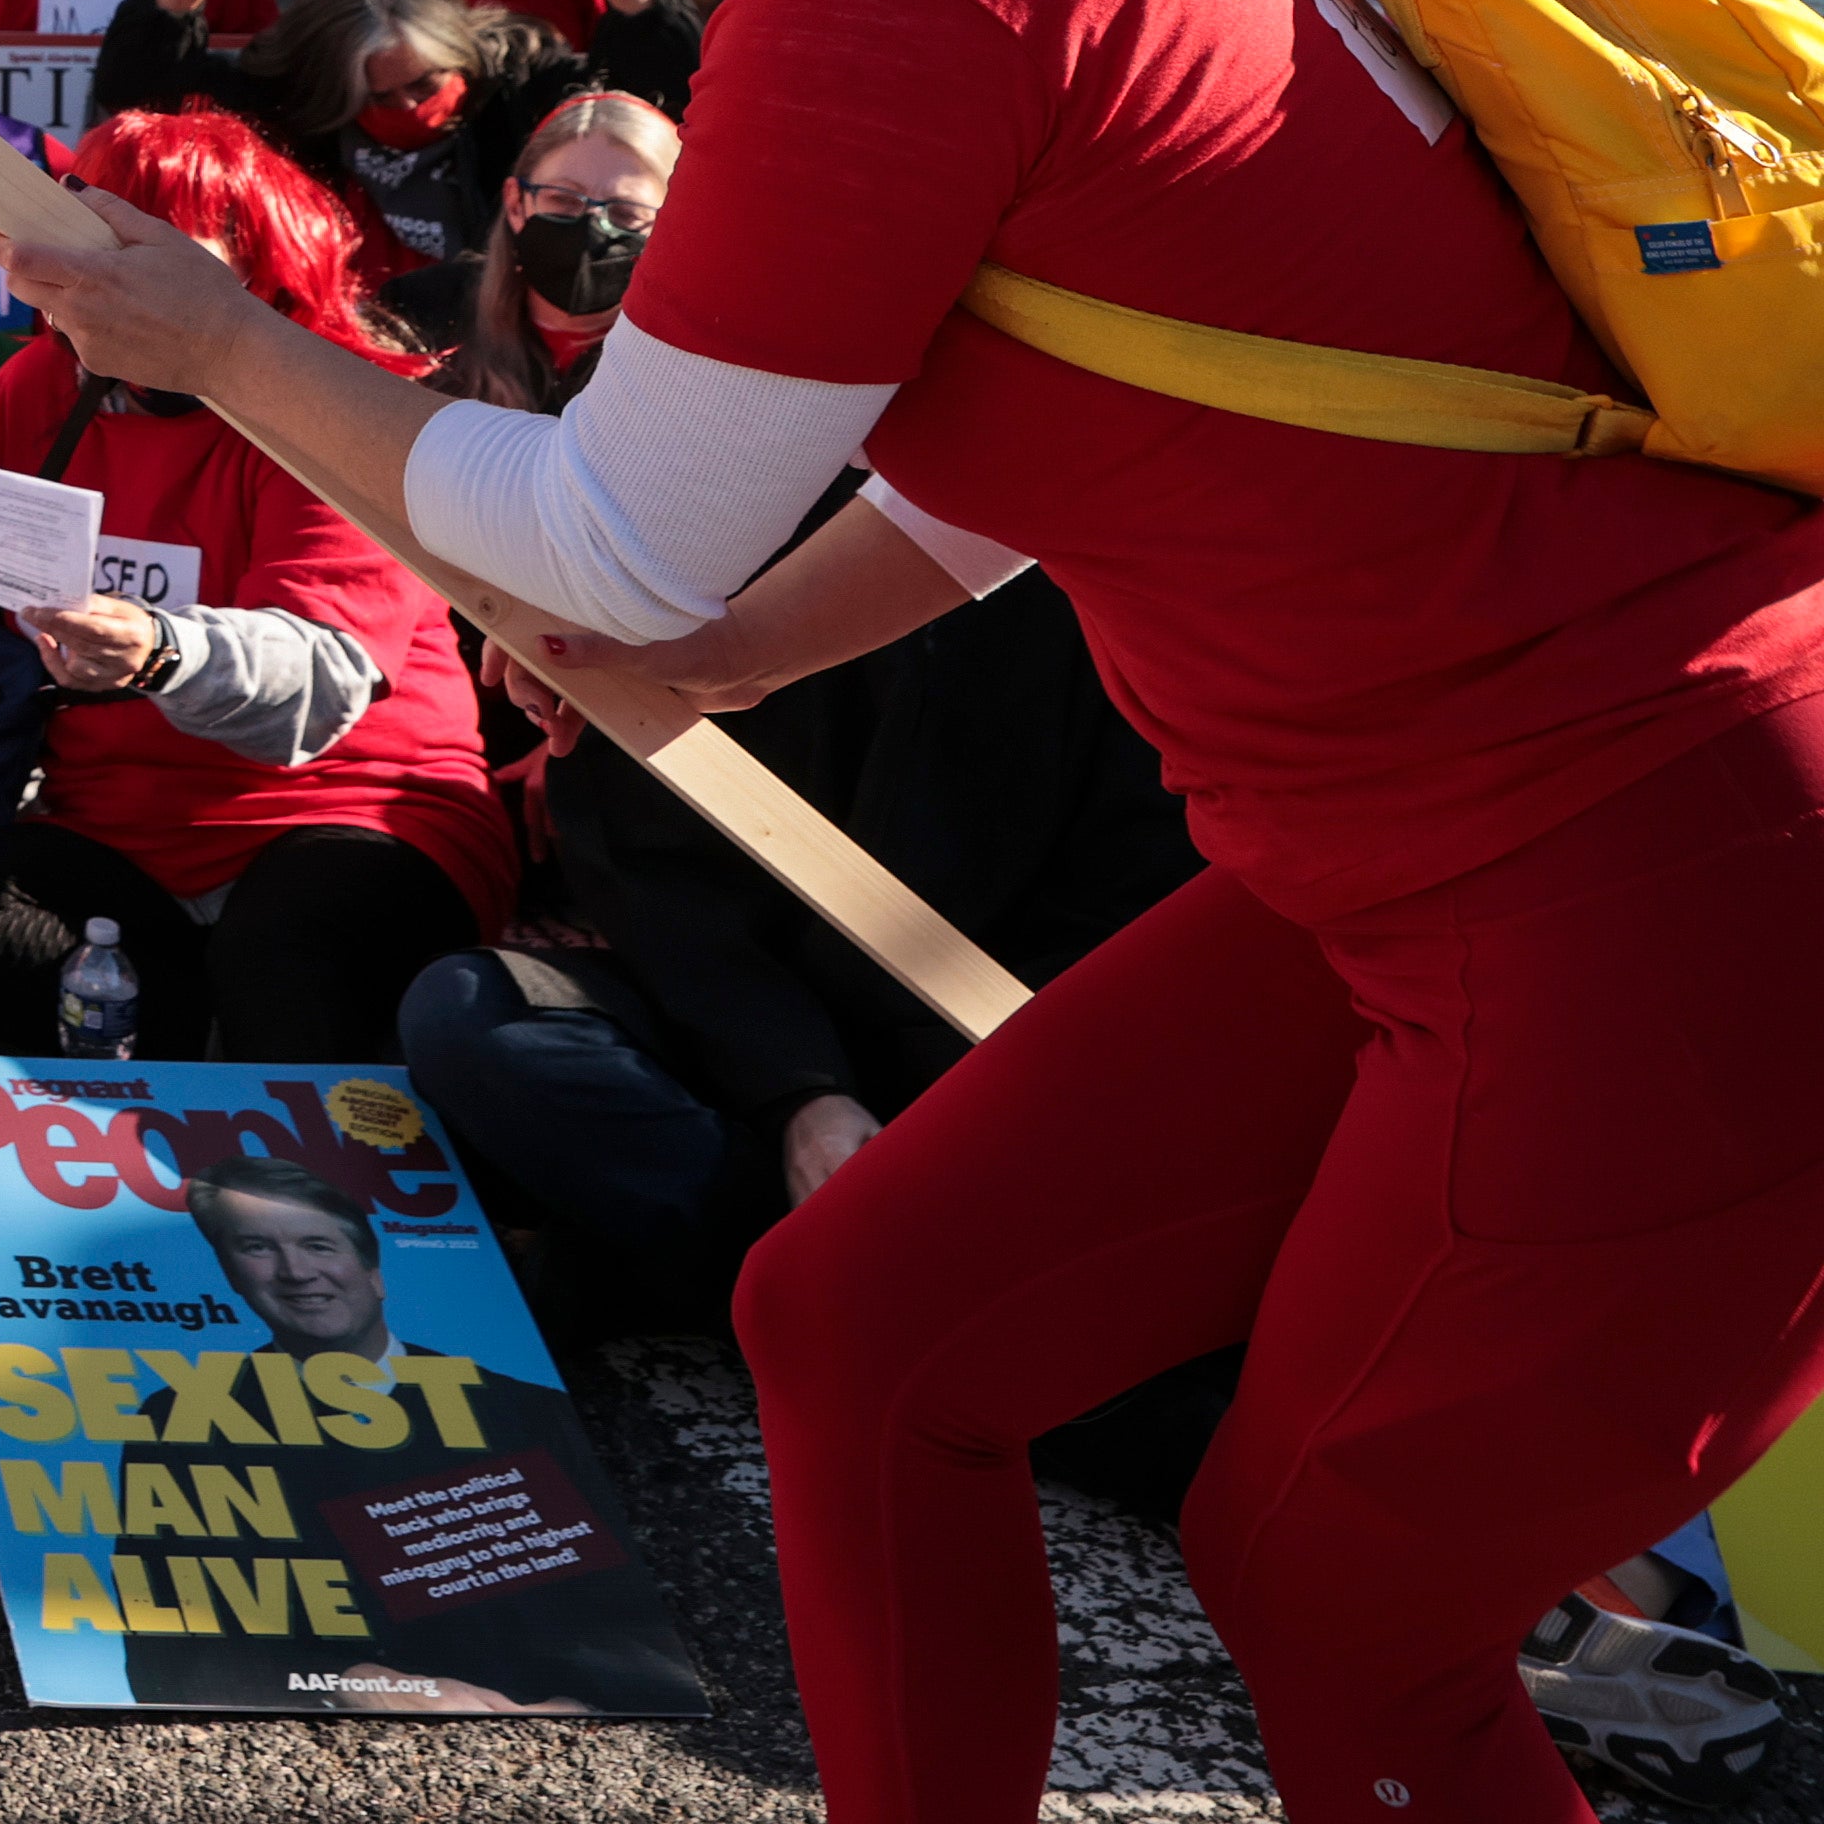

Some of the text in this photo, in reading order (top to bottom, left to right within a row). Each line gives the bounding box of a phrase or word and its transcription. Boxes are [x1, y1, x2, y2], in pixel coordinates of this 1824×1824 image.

[10, 1079, 155, 1104] regnant
[381, 1221, 479, 1237] Magazine
[14, 1256, 157, 1293] Brett
[365, 1467, 525, 1519] Meet the political
[383, 1492, 532, 1537] hack who brings
[379, 1521, 593, 1586] misogyny to the highest
[403, 1510, 543, 1556] mediocrity and
[427, 1547, 580, 1598] court in the land!
[41, 1553, 371, 1638] ALIVE
[287, 1670, 439, 1700] AAFront.org
